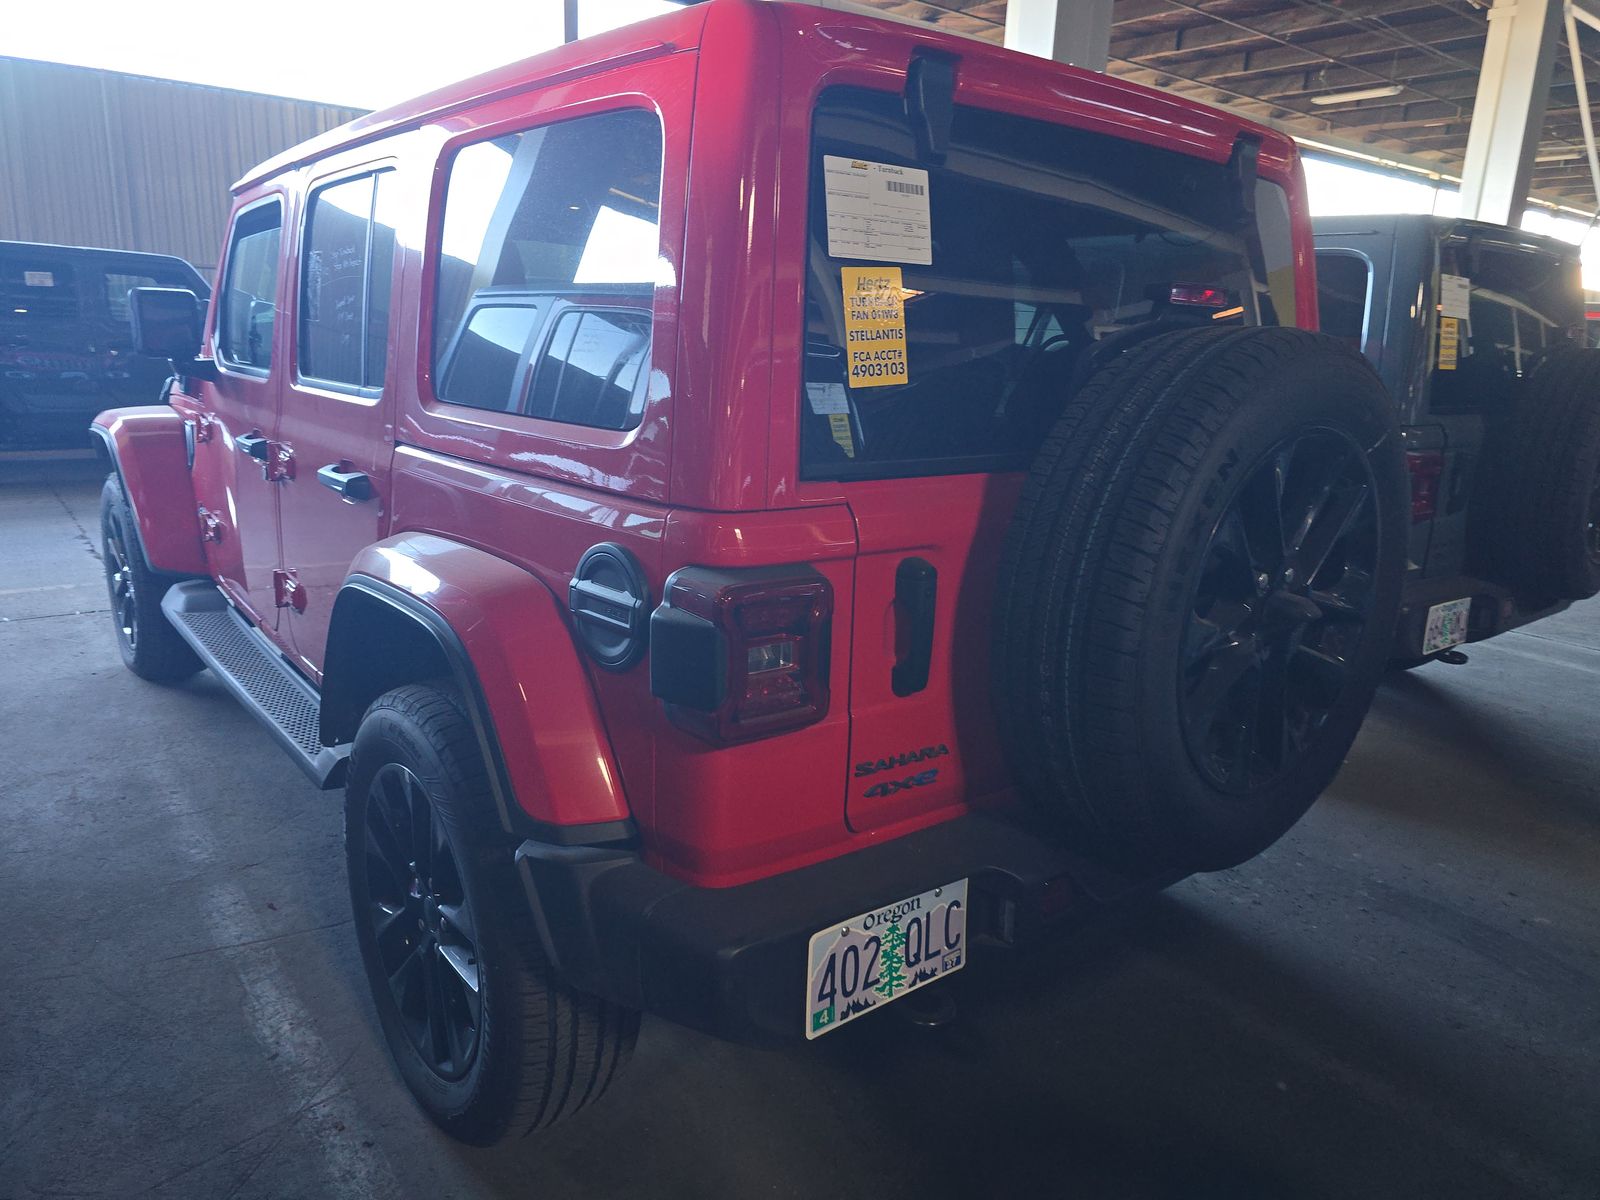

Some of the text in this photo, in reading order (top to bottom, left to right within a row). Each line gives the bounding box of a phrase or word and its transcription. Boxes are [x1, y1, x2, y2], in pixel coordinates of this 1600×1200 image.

[857, 277, 891, 291] Hertz
[851, 310, 869, 320] FAN
[849, 329, 904, 341] STELLANTIS
[853, 349, 903, 362] FCA ACCT#
[852, 362, 905, 377] 4903103
[854, 743, 949, 778] SAHARA
[863, 897, 921, 930] Oregon
[817, 899, 962, 1008] 402 QLC
[819, 1009, 829, 1025] 4
